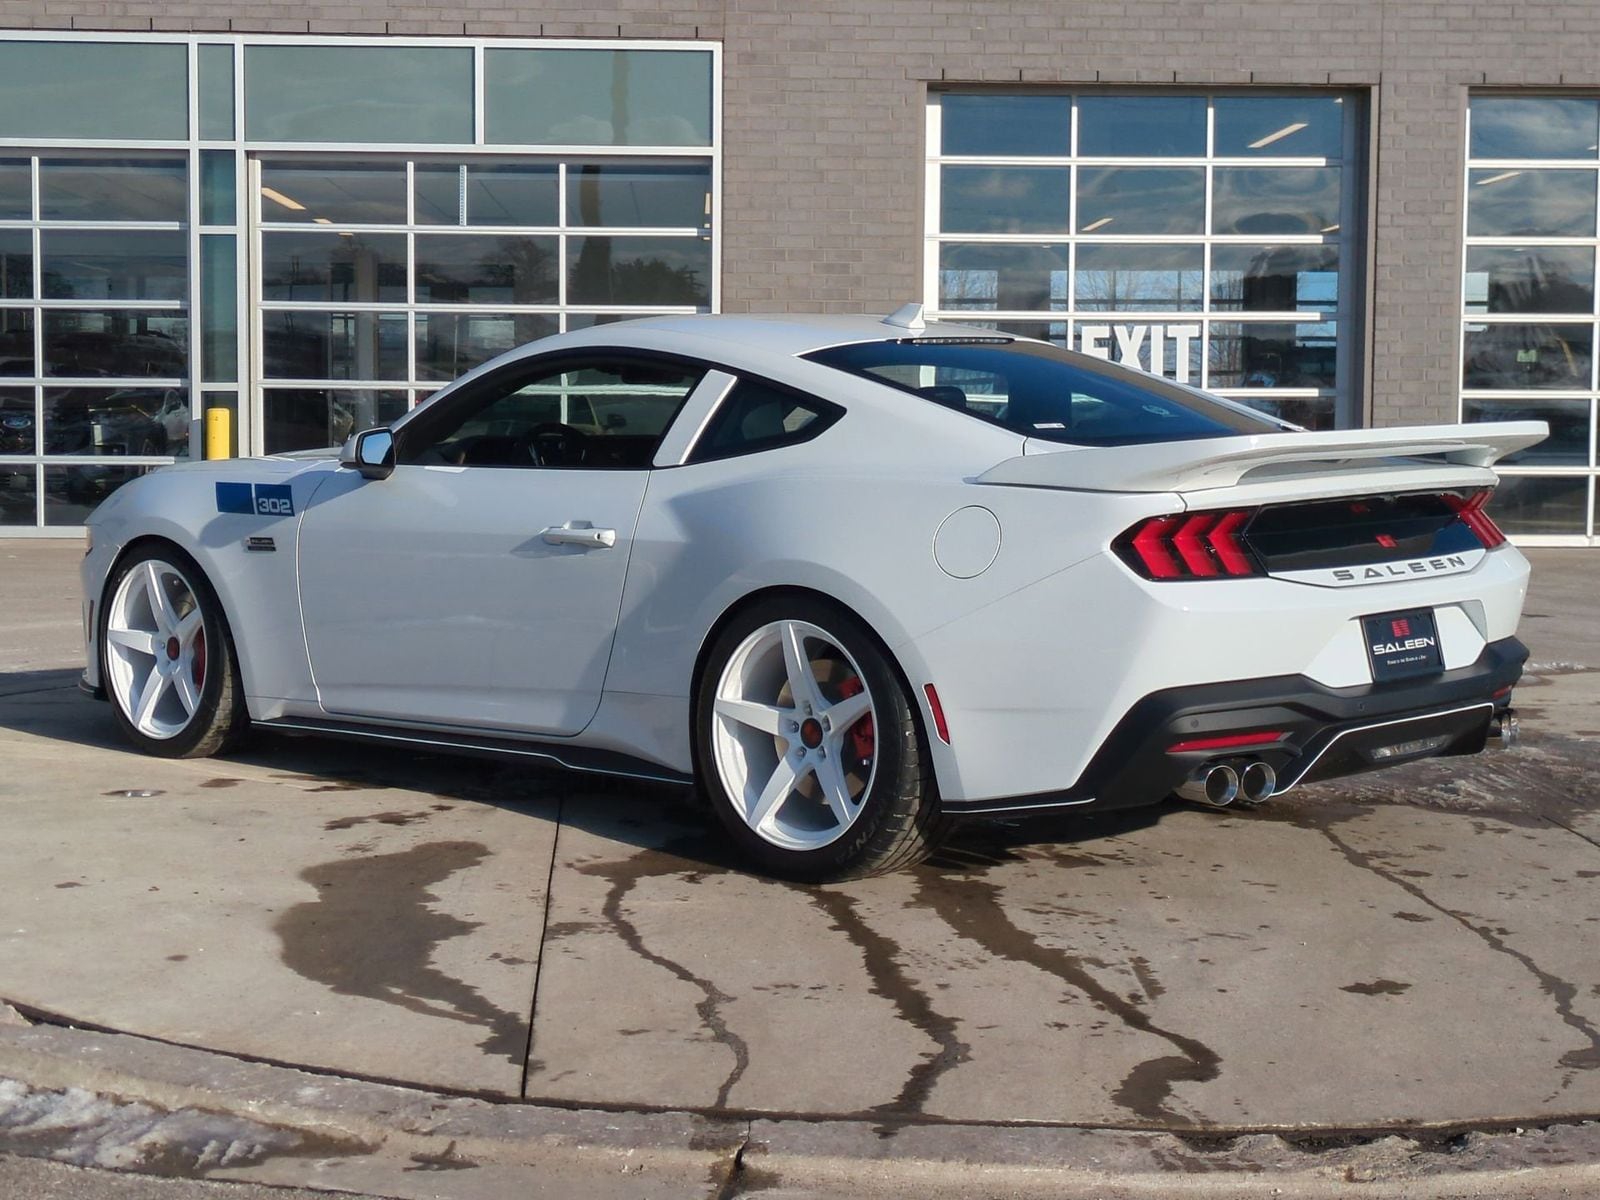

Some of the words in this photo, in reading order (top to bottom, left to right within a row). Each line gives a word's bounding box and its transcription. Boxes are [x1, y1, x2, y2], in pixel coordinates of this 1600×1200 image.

[1081, 325, 1199, 383] EXIT
[258, 498, 292, 513] 302
[1332, 556, 1465, 581] SALEEN
[1372, 637, 1435, 655] SALEEN
